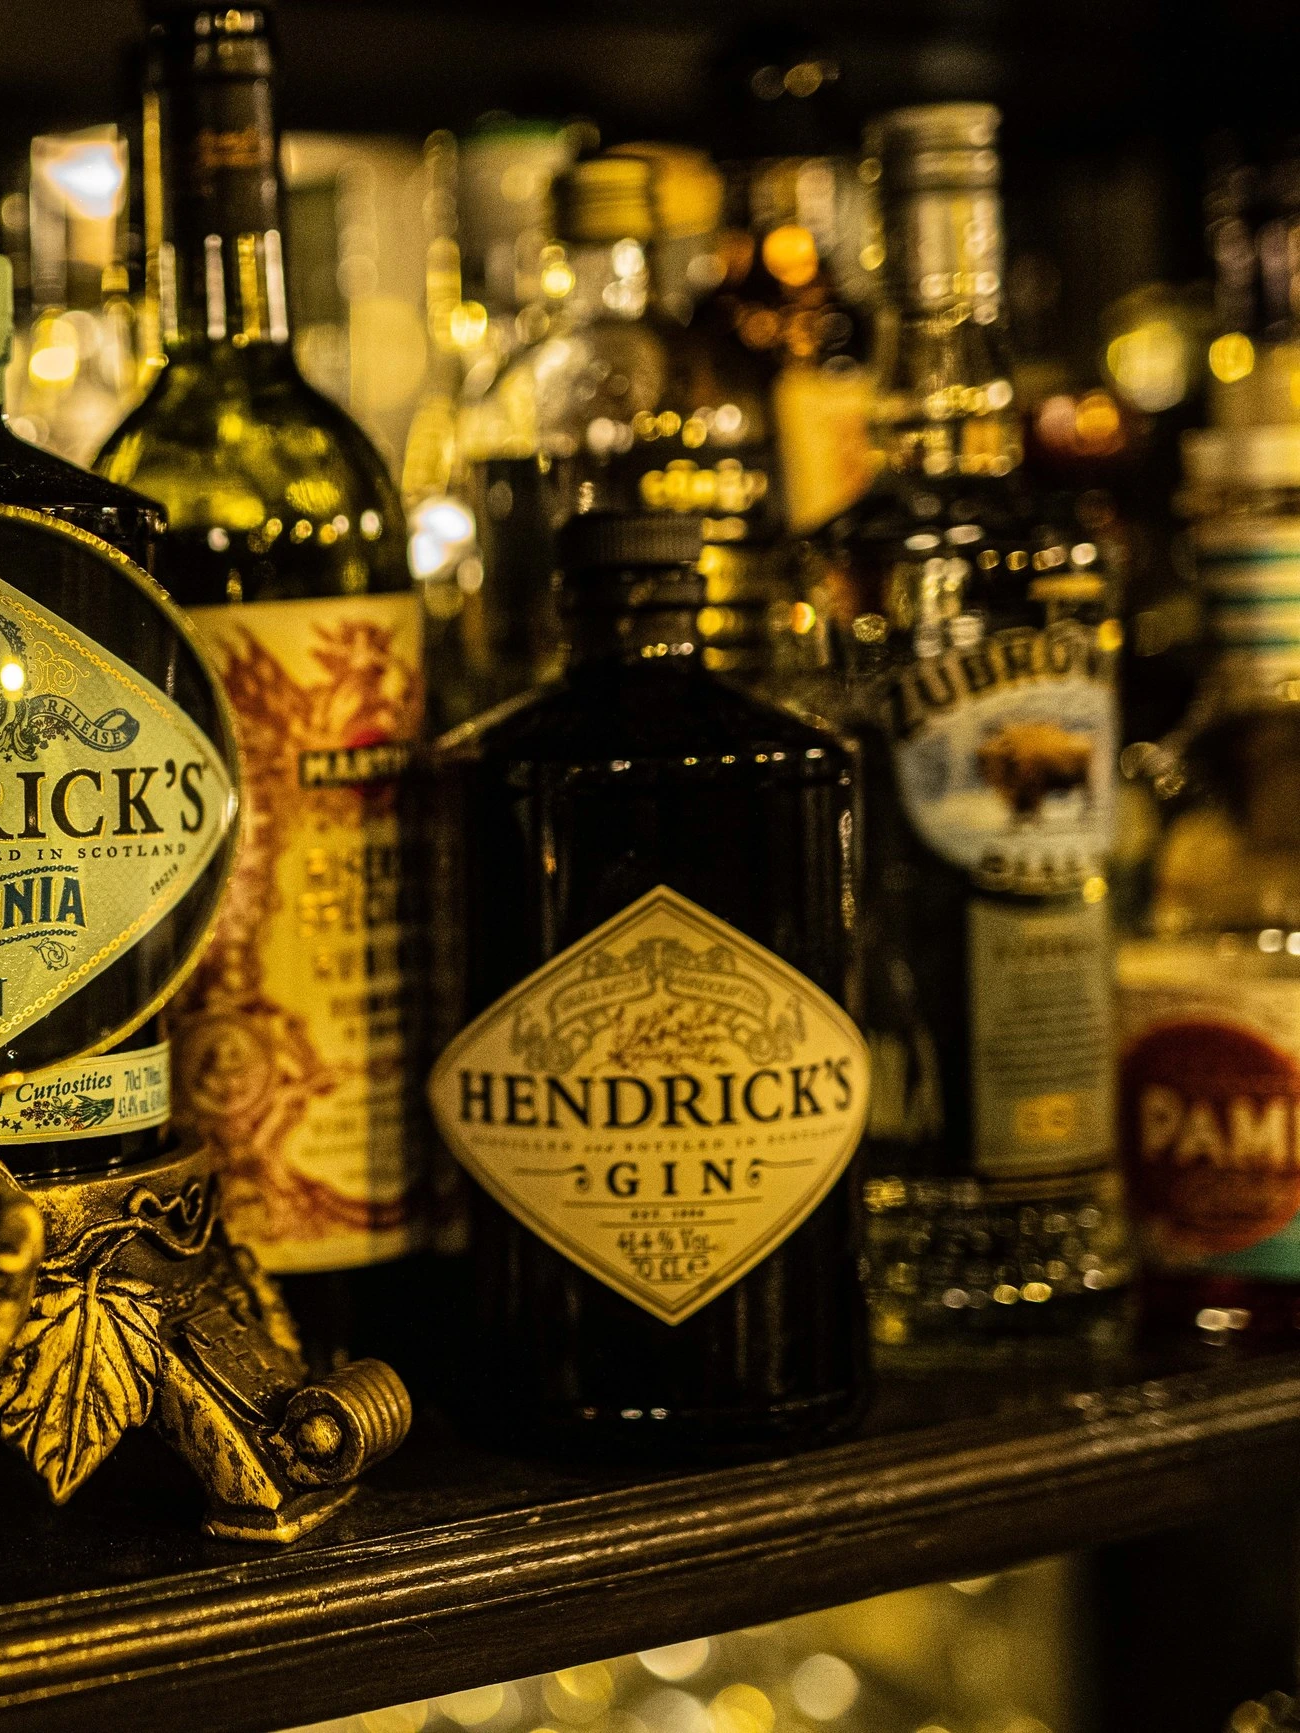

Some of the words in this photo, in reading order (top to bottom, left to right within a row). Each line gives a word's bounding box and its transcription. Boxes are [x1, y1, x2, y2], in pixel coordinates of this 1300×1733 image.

[46, 699, 121, 746] RELEASE
[36, 847, 63, 861] IN
[77, 843, 187, 860] SCOTLAND
[15, 1071, 113, 1103] Curiosities
[458, 1056, 853, 1131] HENDRICK'S
[1140, 1082, 1300, 1168] PAM
[606, 1158, 735, 1199] GIN
